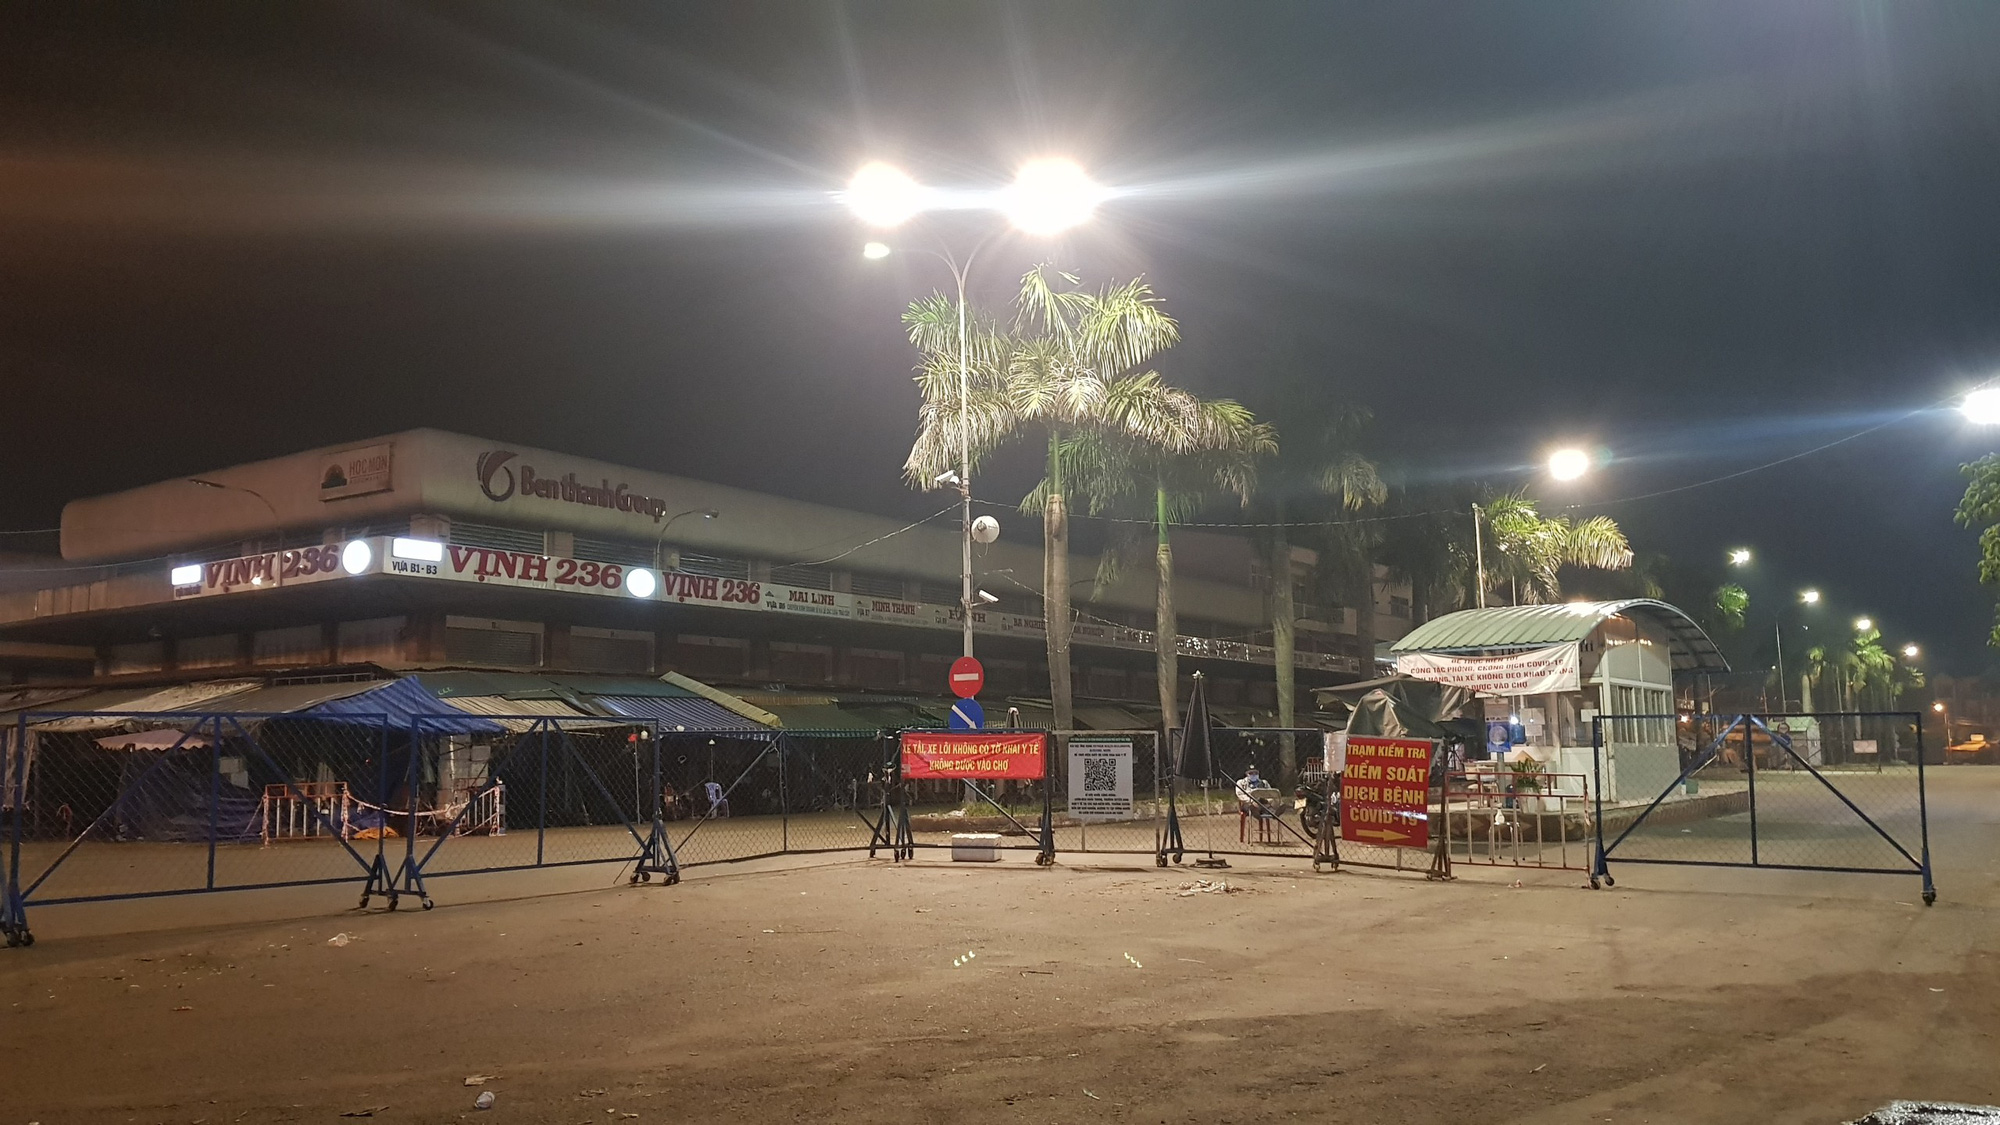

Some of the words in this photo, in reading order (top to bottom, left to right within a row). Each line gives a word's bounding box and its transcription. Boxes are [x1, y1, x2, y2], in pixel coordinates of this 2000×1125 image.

[204, 554, 275, 592] VỊNH
[283, 545, 338, 578] 236
[410, 563, 420, 573] B1
[426, 565, 437, 574] B3
[446, 544, 551, 582] VỊNH
[555, 558, 622, 588] 236
[662, 572, 719, 602] VỊNH
[722, 580, 760, 604] 236
[789, 590, 808, 602] MAI
[872, 601, 890, 612] MINH
[902, 743, 911, 754] XE
[928, 743, 937, 754] XE
[953, 742, 977, 754] KHÔNG
[979, 742, 989, 754] CÓ
[1002, 743, 1020, 754] KHAI
[1022, 744, 1028, 754] Y
[1029, 741, 1039, 754] TẾ
[1348, 744, 1375, 758] TRẠM
[1378, 742, 1403, 757] KIỂM
[1407, 748, 1426, 759] TRA
[930, 758, 954, 771] KHÔNG
[977, 758, 992, 770] VÀO
[992, 759, 1009, 772] CHỢ
[1344, 760, 1381, 780] KIỂM
[1386, 765, 1426, 782] SOÁT
[1344, 785, 1379, 803] DỊCH
[1383, 786, 1424, 806] BỆNH
